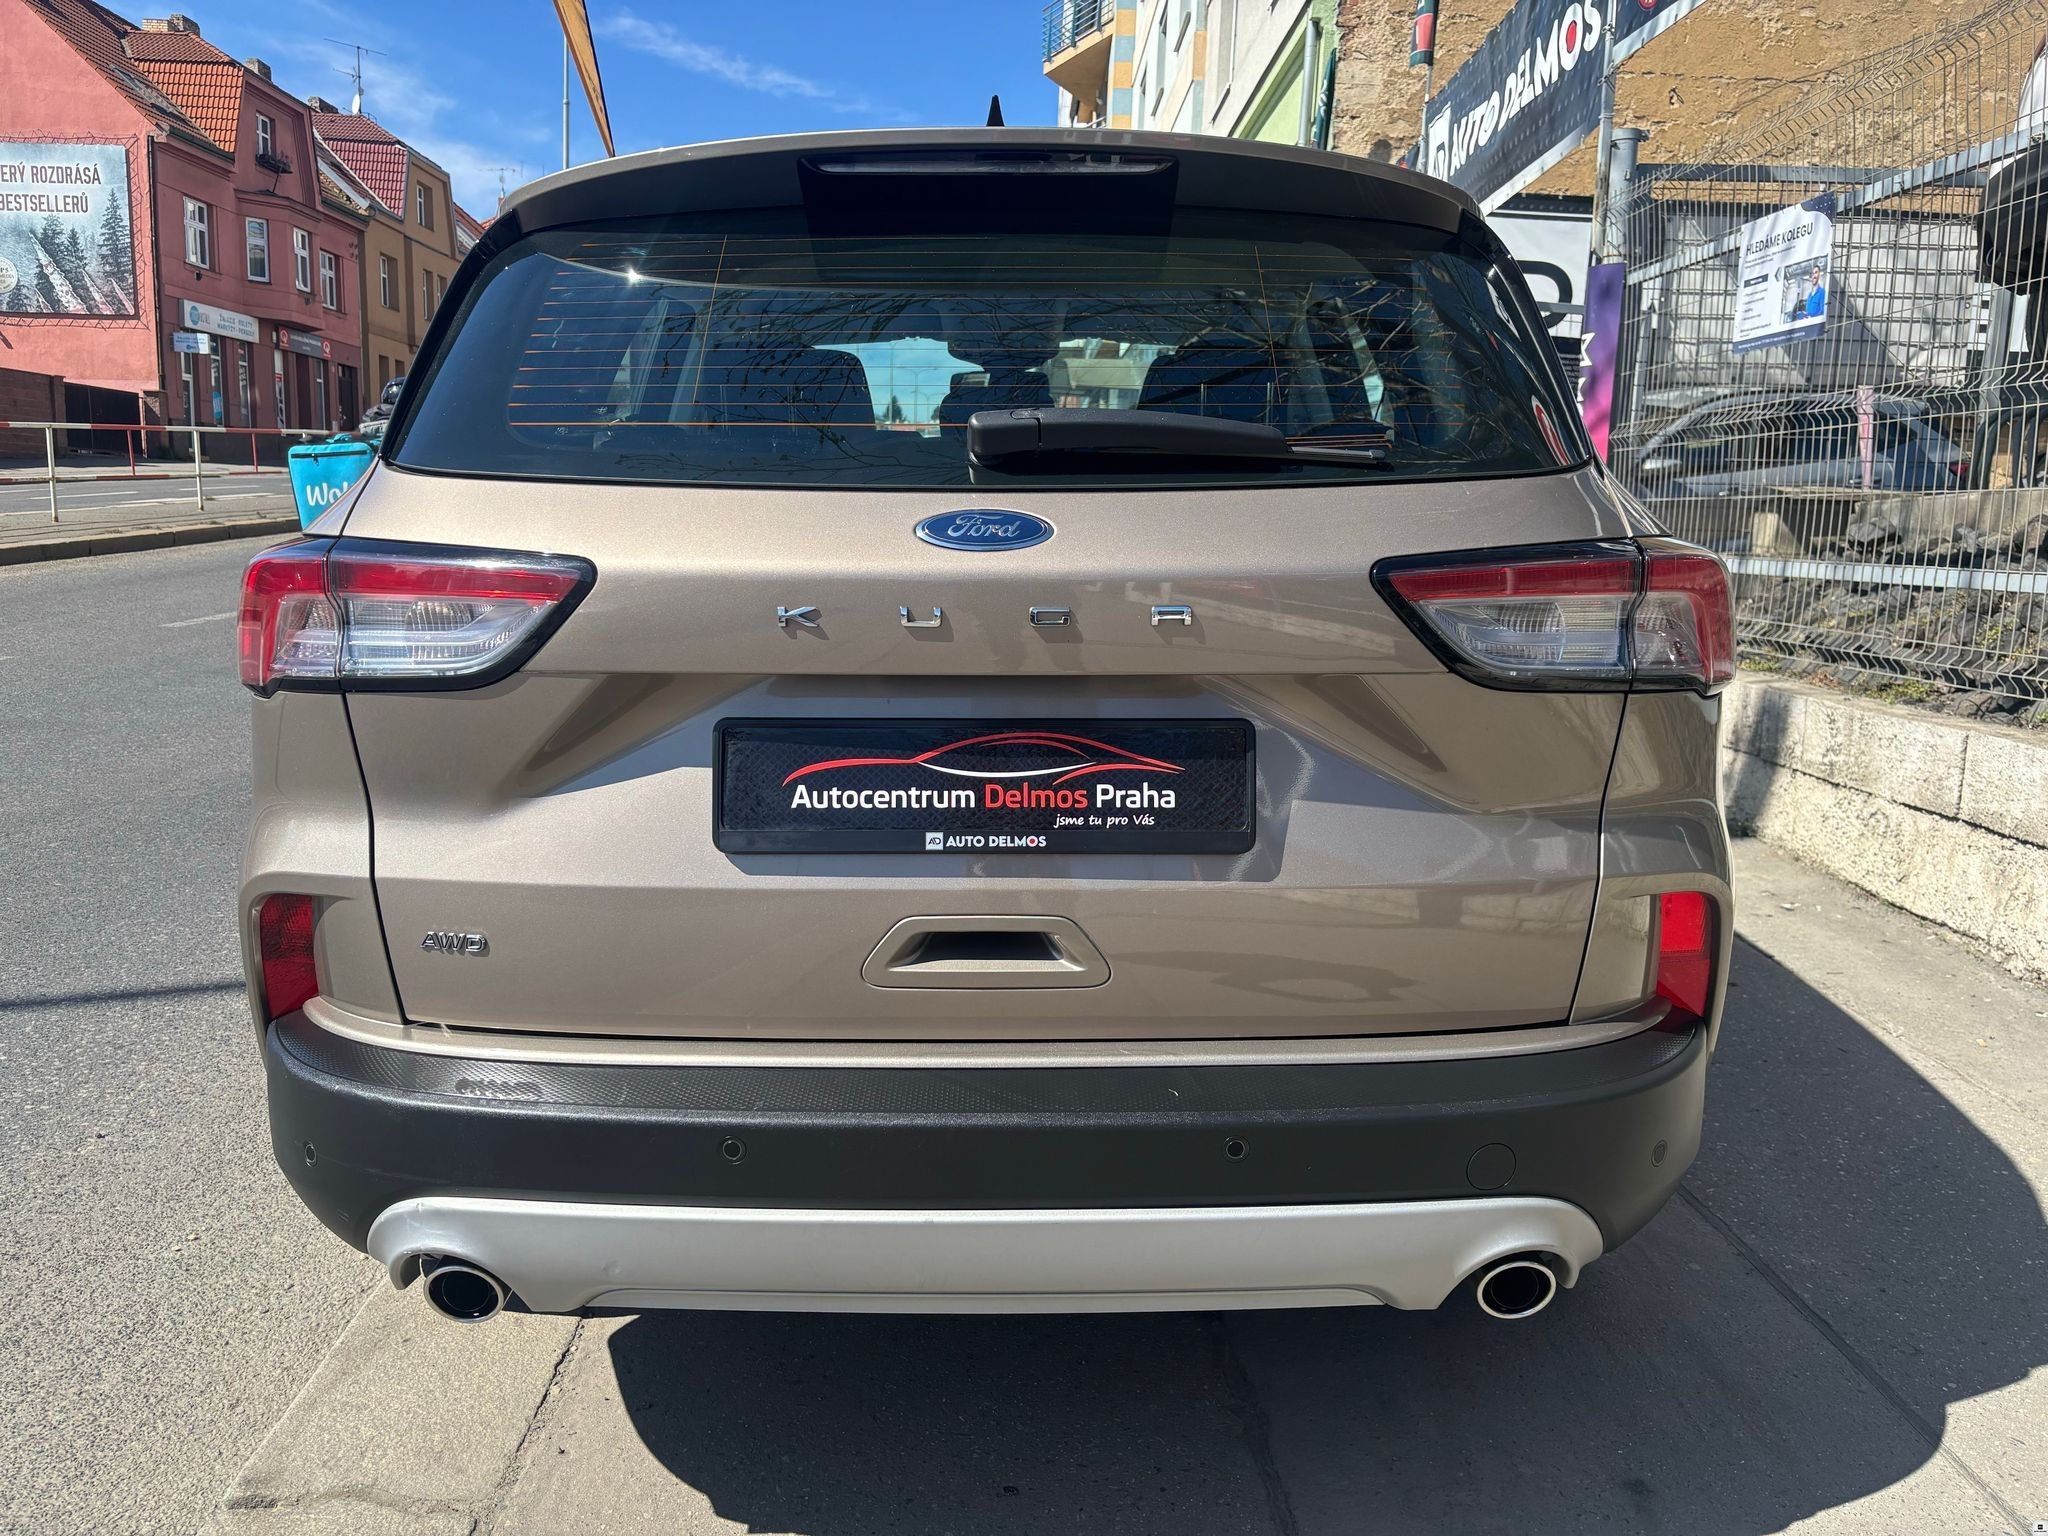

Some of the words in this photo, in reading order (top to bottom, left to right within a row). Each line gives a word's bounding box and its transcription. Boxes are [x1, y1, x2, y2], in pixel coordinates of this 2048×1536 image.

[1450, 91, 1501, 176] AUTO
[1498, 0, 1602, 132] DELMOS
[30, 163, 102, 185] ROZDRÁSÁ
[1745, 233, 1781, 257] HLEDÁME
[1781, 222, 1814, 245] KOLEGU
[947, 513, 1020, 538] Ford
[776, 604, 1193, 628] KUGA
[790, 784, 976, 809] Autocentrum
[984, 782, 1089, 809] Delmos
[1096, 782, 1176, 809] Praha
[1053, 813, 1085, 829] jsme
[1088, 815, 1103, 826] tu
[1106, 817, 1129, 829] pro
[1133, 813, 1156, 826] Vás
[945, 835, 985, 848] AUTO
[988, 835, 1047, 848] DELMOS
[420, 931, 488, 953] AWD
